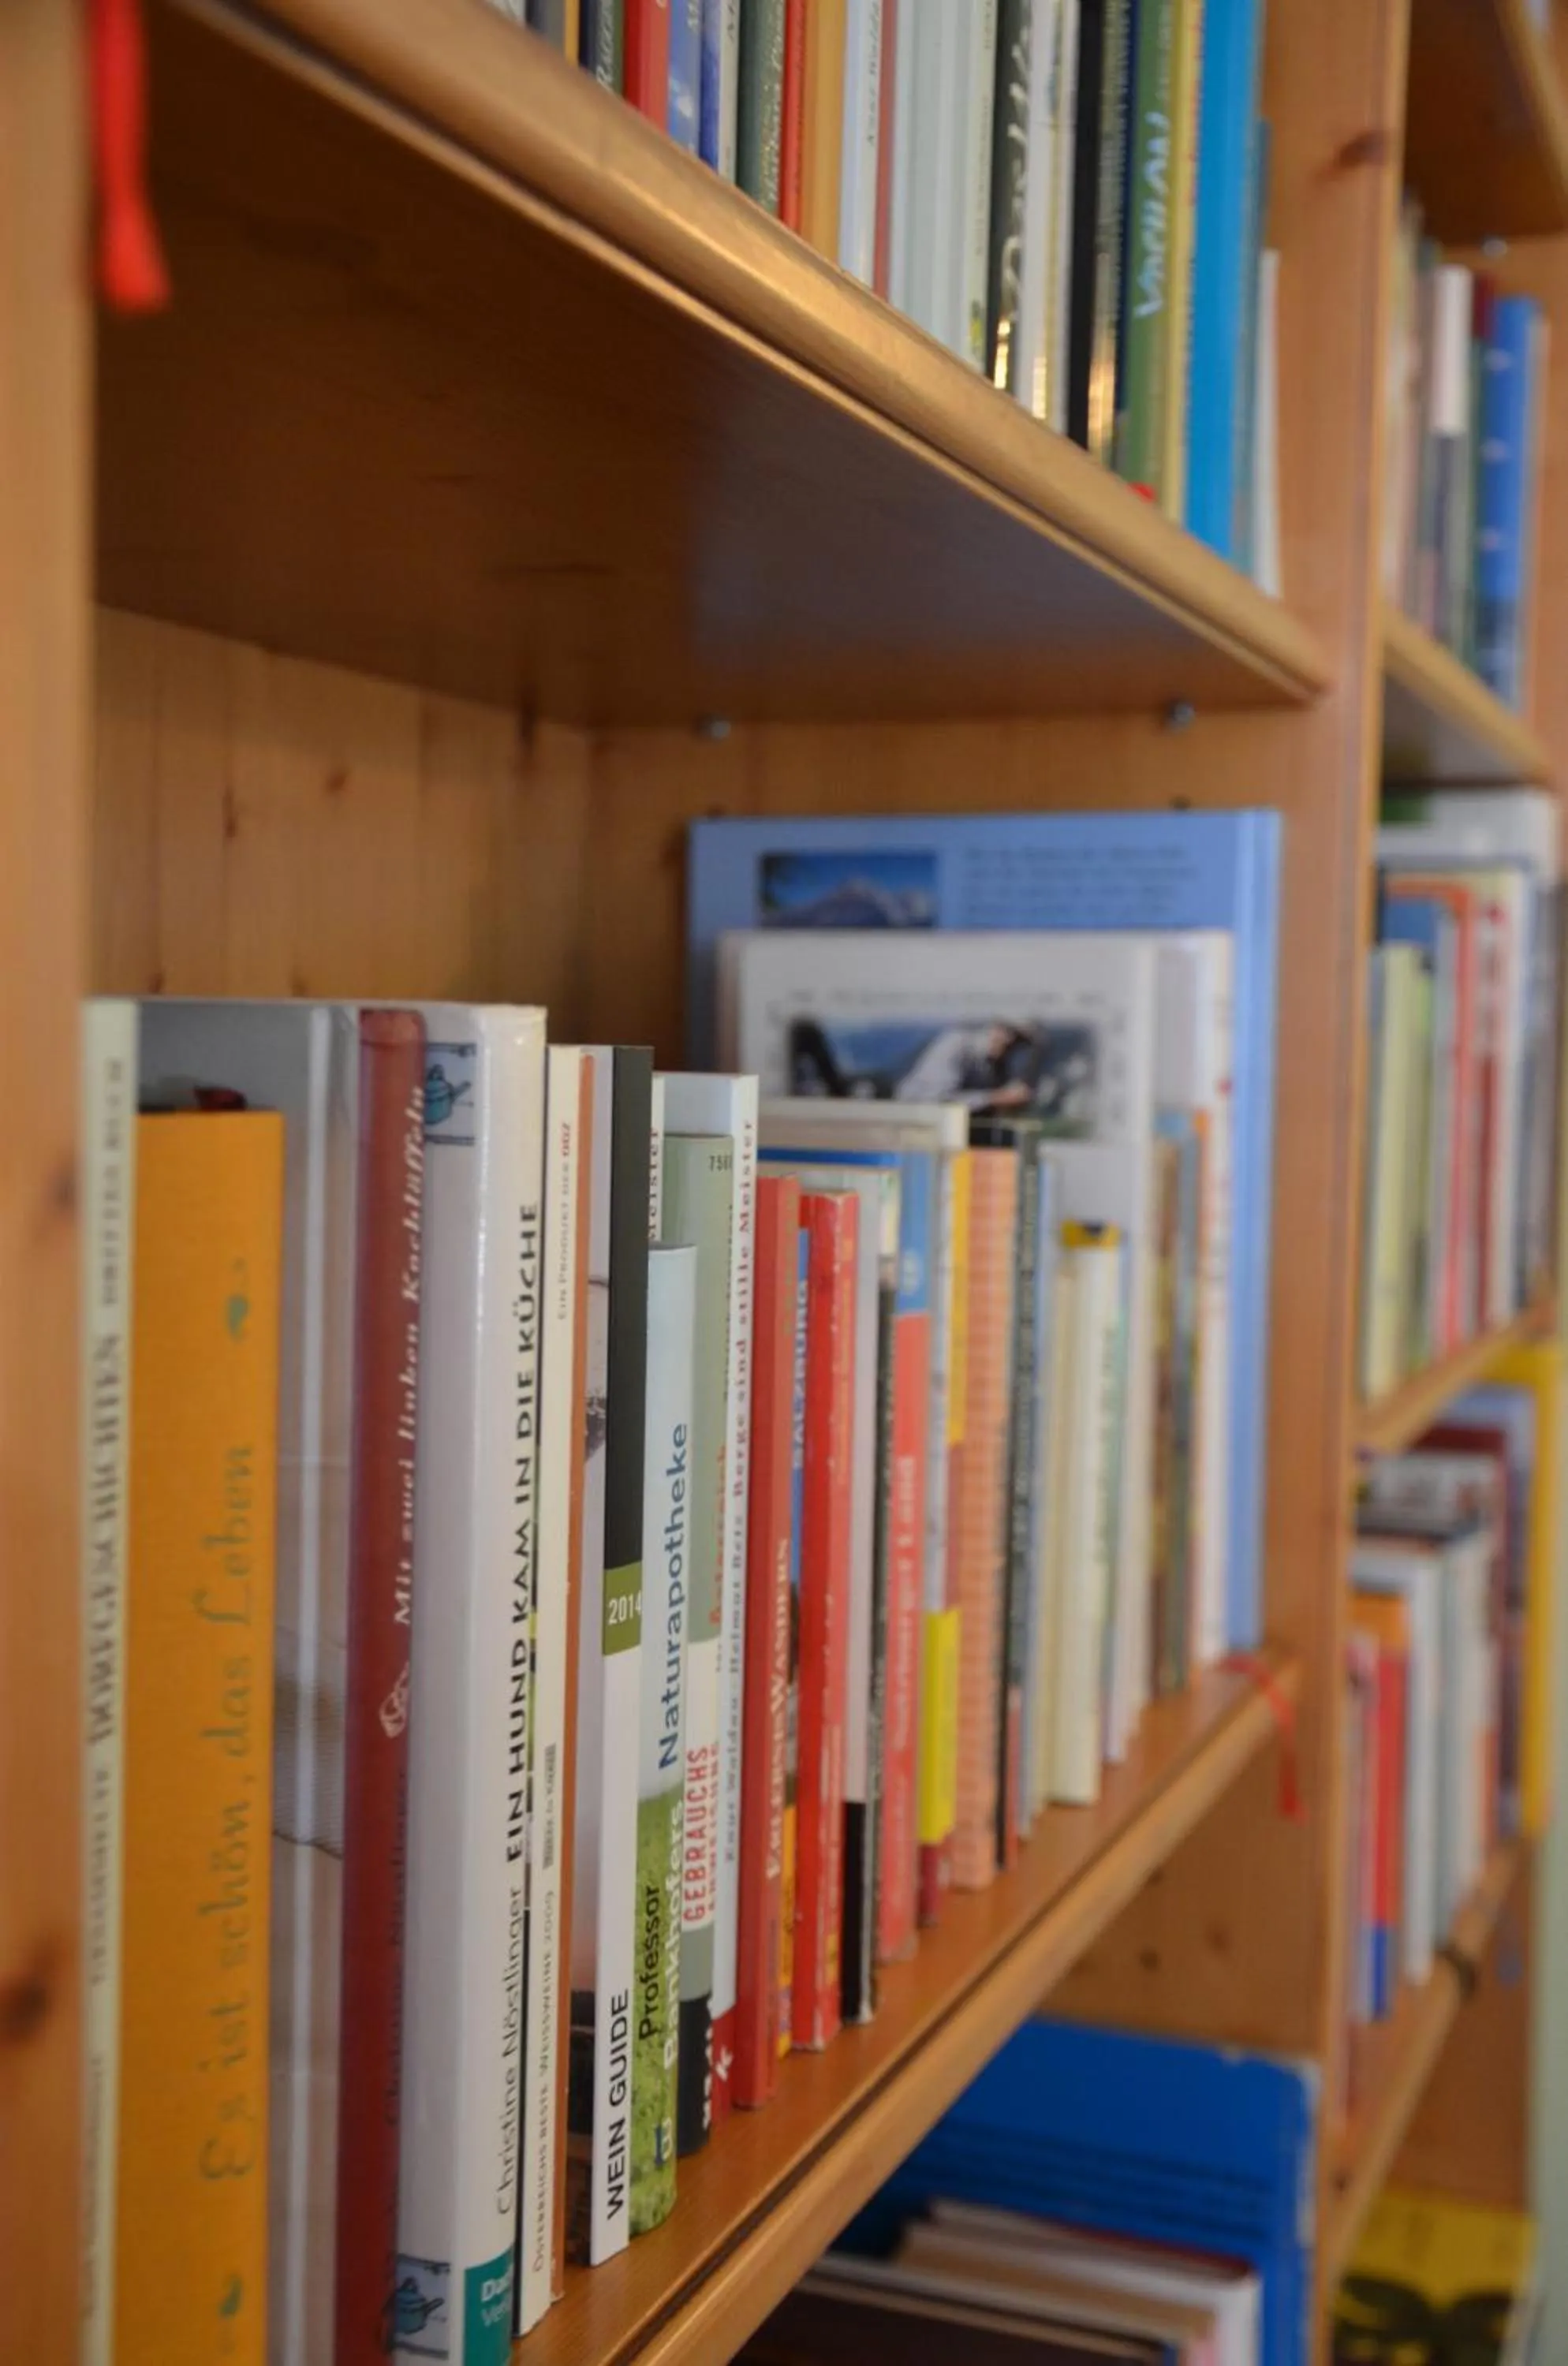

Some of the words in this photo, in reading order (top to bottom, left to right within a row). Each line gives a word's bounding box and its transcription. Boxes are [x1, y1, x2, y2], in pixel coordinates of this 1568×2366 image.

[738, 1119, 752, 1233] Meister
[513, 1204, 536, 1353] KÜCHE
[737, 1245, 749, 1325] stille
[397, 1323, 418, 1441] linken
[517, 1371, 533, 1441] DIE
[734, 1338, 746, 1402] sind
[398, 1460, 416, 1542] zwei
[514, 1457, 531, 1504] IN
[732, 1415, 747, 1497] Berge
[191, 1443, 252, 1627] Leben
[512, 1519, 530, 1623] KAM
[393, 1561, 412, 1625] Mit
[608, 1590, 641, 1625] 2014
[657, 1424, 687, 1770] Naturapotheke
[197, 1655, 251, 1760] das
[509, 1636, 527, 1775] HUND
[506, 1790, 524, 1863] EIN
[682, 1745, 708, 1924] GEBRAUCHS
[502, 1887, 521, 2058] Nöstlinger
[638, 1884, 659, 2042] Professor
[662, 1801, 682, 2071] Bankhofers
[194, 1995, 250, 2075] ist
[609, 1989, 628, 2107] GUIDE
[497, 2068, 517, 2215] Christine
[607, 2117, 625, 2220] WEIN
